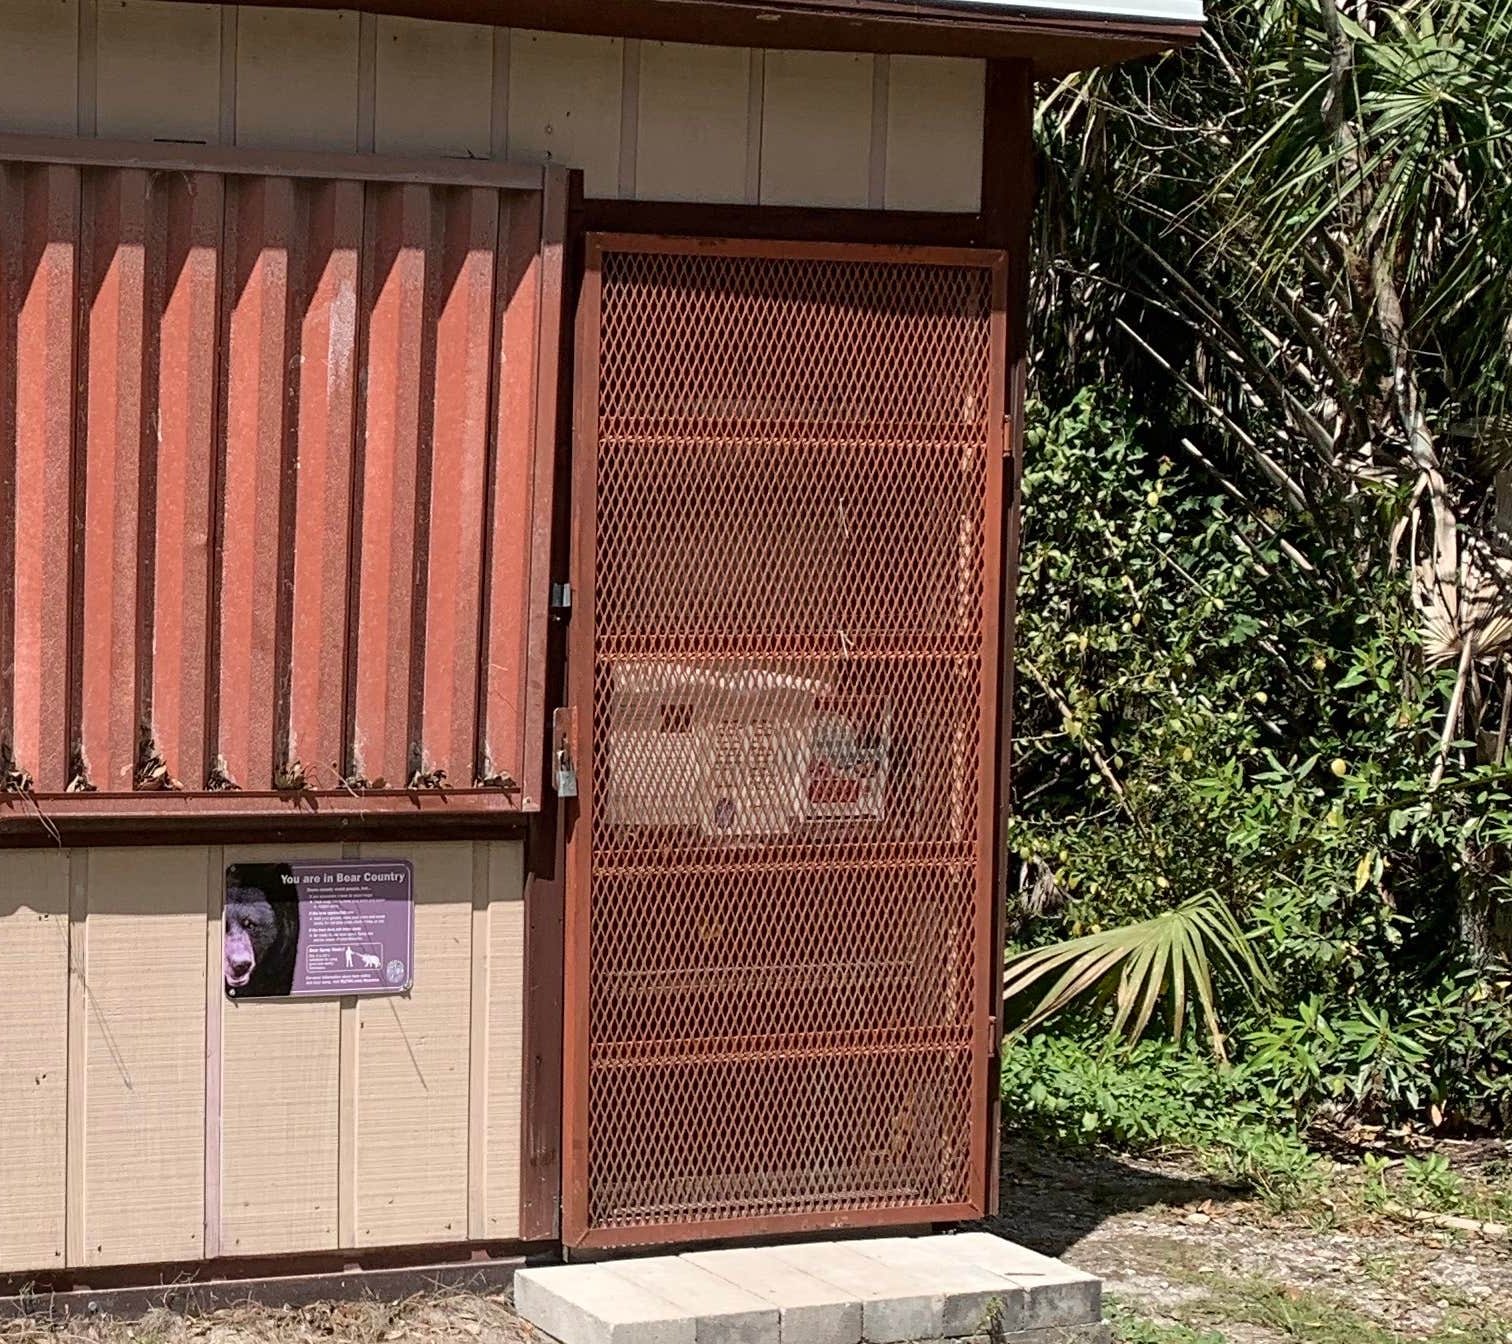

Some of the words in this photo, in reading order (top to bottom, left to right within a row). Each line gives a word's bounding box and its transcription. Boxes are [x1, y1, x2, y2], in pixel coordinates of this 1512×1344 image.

[280, 874, 300, 885] You
[303, 874, 321, 884] are
[323, 872, 334, 883] in
[336, 872, 361, 883] Bear
[363, 871, 406, 884] Country
